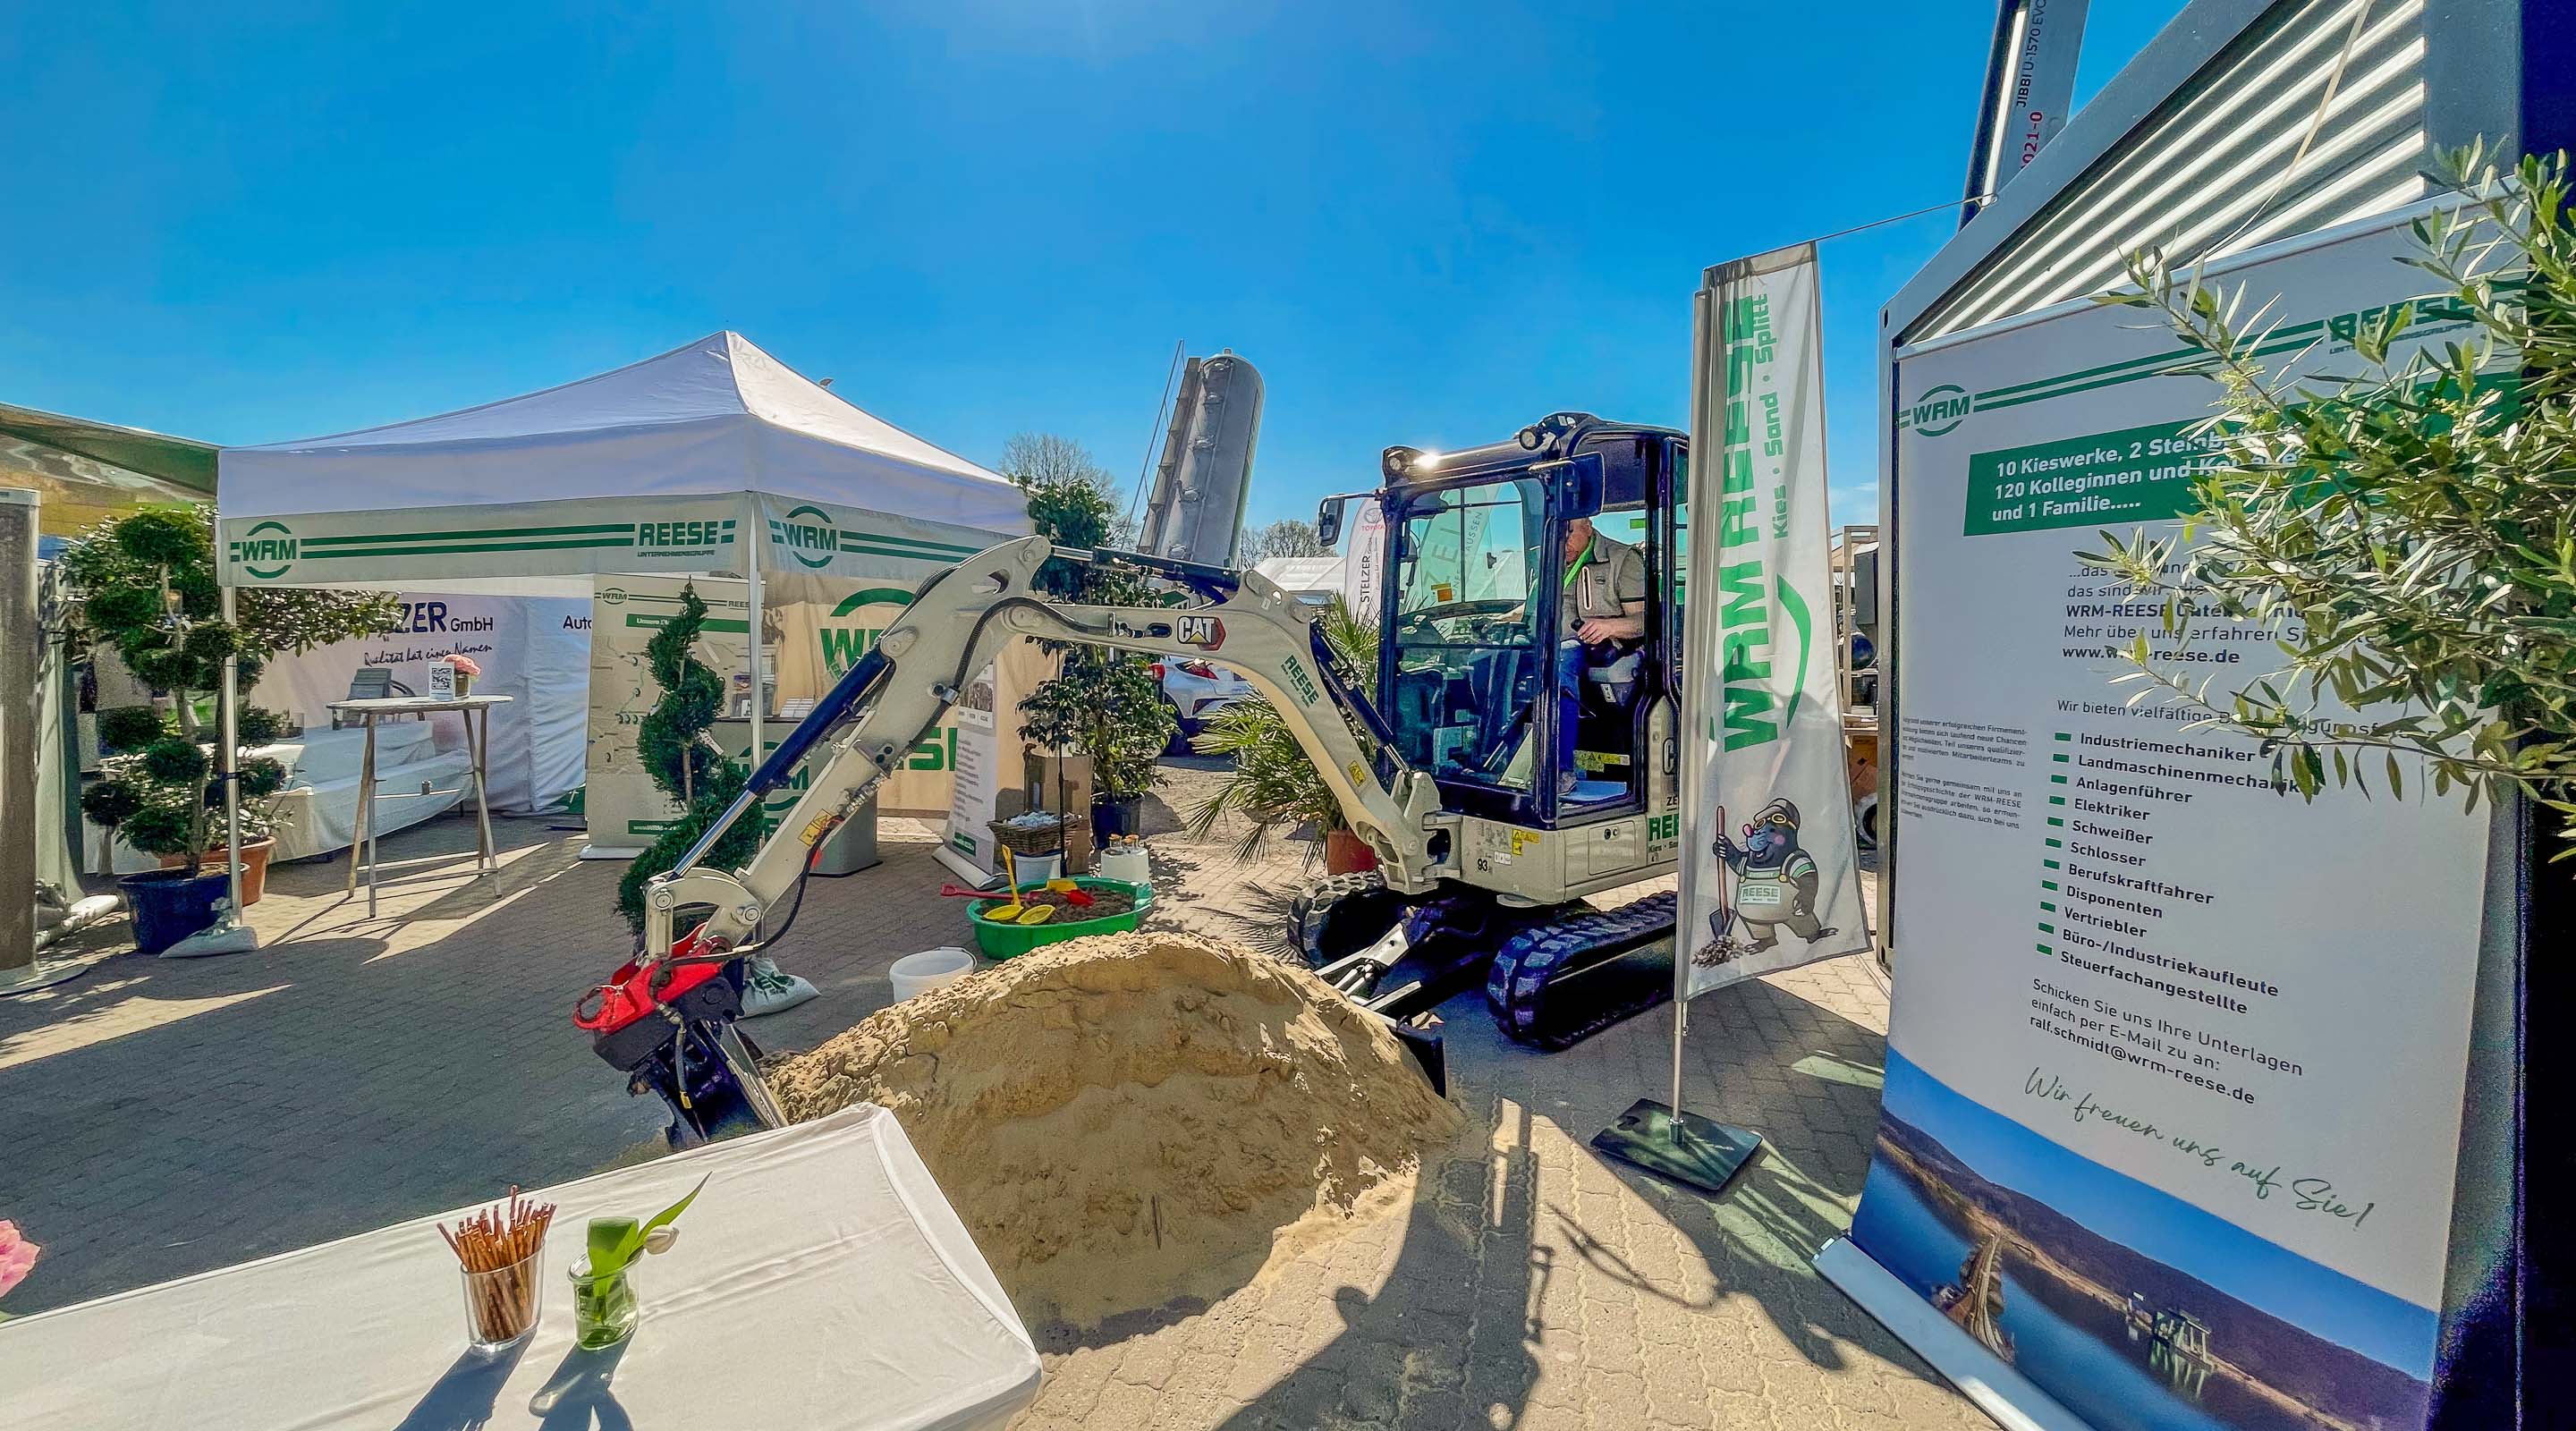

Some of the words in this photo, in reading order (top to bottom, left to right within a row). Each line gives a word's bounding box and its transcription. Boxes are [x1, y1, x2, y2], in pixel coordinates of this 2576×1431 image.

[2023, 28, 2042, 72] U-1570
[2016, 73, 2032, 108] JIBBI
[2019, 111, 2044, 170] 021-0
[1751, 292, 1778, 365] Splitt
[1758, 391, 1784, 458] Sand
[1913, 394, 1970, 426] WRM
[1996, 461, 2016, 478] 10
[2021, 447, 2123, 476] Kieswerke,
[2129, 442, 2142, 459] 2
[1995, 483, 2024, 500] 120
[2029, 470, 2142, 496] Kolleginnen
[2149, 461, 2190, 482] und
[1772, 484, 1789, 539] Kies
[1992, 500, 2022, 522] und
[2029, 501, 2037, 518] 1
[2042, 493, 2141, 517] Familie.....
[241, 541, 297, 562] WRM
[639, 521, 718, 546] REESE
[782, 521, 838, 552] WRM
[1465, 511, 1483, 552] AUSSEN
[1360, 555, 1371, 603] STELZER
[2067, 584, 2093, 598] das
[2098, 583, 2132, 597] sind
[602, 591, 628, 601] WRM
[450, 616, 494, 632] GmbH
[1177, 616, 1216, 644] CAT
[2063, 624, 2103, 639] Mehr
[2106, 624, 2140, 639] übe
[2151, 628, 2182, 640] uns
[2190, 625, 2278, 642] erfahren
[406, 647, 424, 662] hat
[1720, 560, 1778, 753] WRM
[2063, 647, 2241, 664] www.w-reese.de
[1284, 654, 1319, 705] REESE
[2057, 700, 2079, 713] Wir
[2082, 702, 2126, 716] bieten
[2131, 706, 2220, 724] vielfältige
[1996, 736, 2027, 746] Chancen
[2080, 732, 2256, 762] Industriemechaniker
[2079, 754, 2302, 793] Landmaschinenmechak
[1958, 792, 1970, 800] der
[1974, 793, 2021, 809] WRM-REESE
[1997, 788, 2011, 796] uns
[2076, 776, 2193, 804] Anlagenführer
[1982, 806, 1991, 814] so
[2006, 820, 2020, 830] uns
[2074, 798, 2151, 821] Elektriker
[2072, 819, 2153, 844] Schweißer
[1477, 858, 1488, 872] 93
[2070, 841, 2147, 867] Schlosser
[2068, 862, 2215, 905] Berufskraftfahrer
[2065, 885, 2163, 919] Disponenten
[2063, 906, 2148, 938] Vertriebler
[2063, 927, 2280, 997] Büro-/Industriekaufleute
[2060, 950, 2248, 1015] Steuerfachangestellte
[2030, 997, 2077, 1024] einfach
[2080, 1016, 2106, 1036] per
[2109, 1024, 2162, 1052] E-Mail
[2166, 1044, 2188, 1062] zu
[2192, 1051, 2221, 1072] an:
[2032, 978, 2089, 1009] Schicken
[2093, 999, 2118, 1018] Sie
[2123, 1010, 2152, 1029] uns
[2157, 1019, 2191, 1041] Ihre
[2198, 1030, 2304, 1077] Unterlagen
[2029, 1014, 2256, 1105] ralf.schmidt@wrm-reese.de
[2024, 1066, 2072, 1103] Wir
[2073, 1092, 2165, 1141] freuen
[2172, 1133, 2227, 1167] uns
[2230, 1160, 2284, 1201] auf
[2291, 1177, 2377, 1233] Sie!
